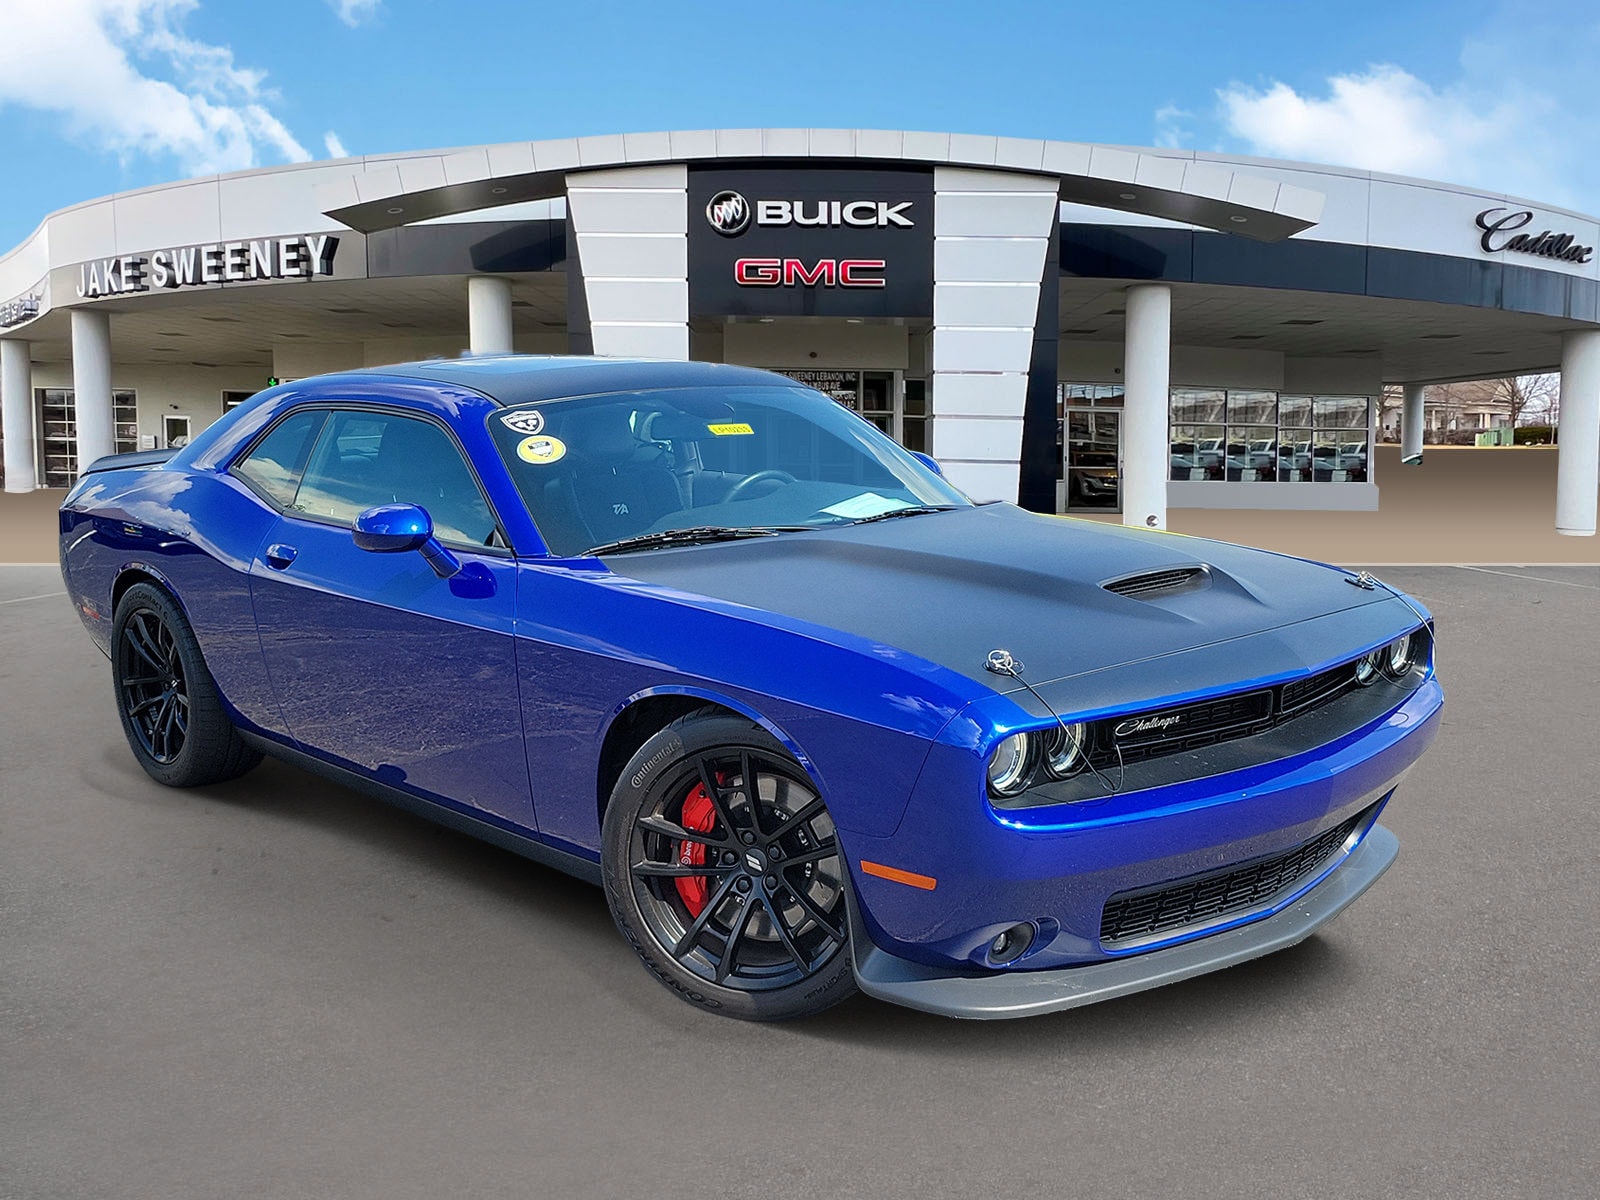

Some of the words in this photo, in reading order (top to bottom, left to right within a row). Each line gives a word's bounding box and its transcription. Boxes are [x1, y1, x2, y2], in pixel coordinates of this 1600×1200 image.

[757, 200, 915, 227] BUICK
[1475, 207, 1593, 264] Cadillac
[76, 256, 142, 298] JAKE
[152, 235, 335, 289] SWEENEY
[735, 258, 886, 287] GMC
[612, 503, 629, 515] T/A
[1115, 715, 1180, 736] Challenger
[631, 741, 675, 788] Continental
